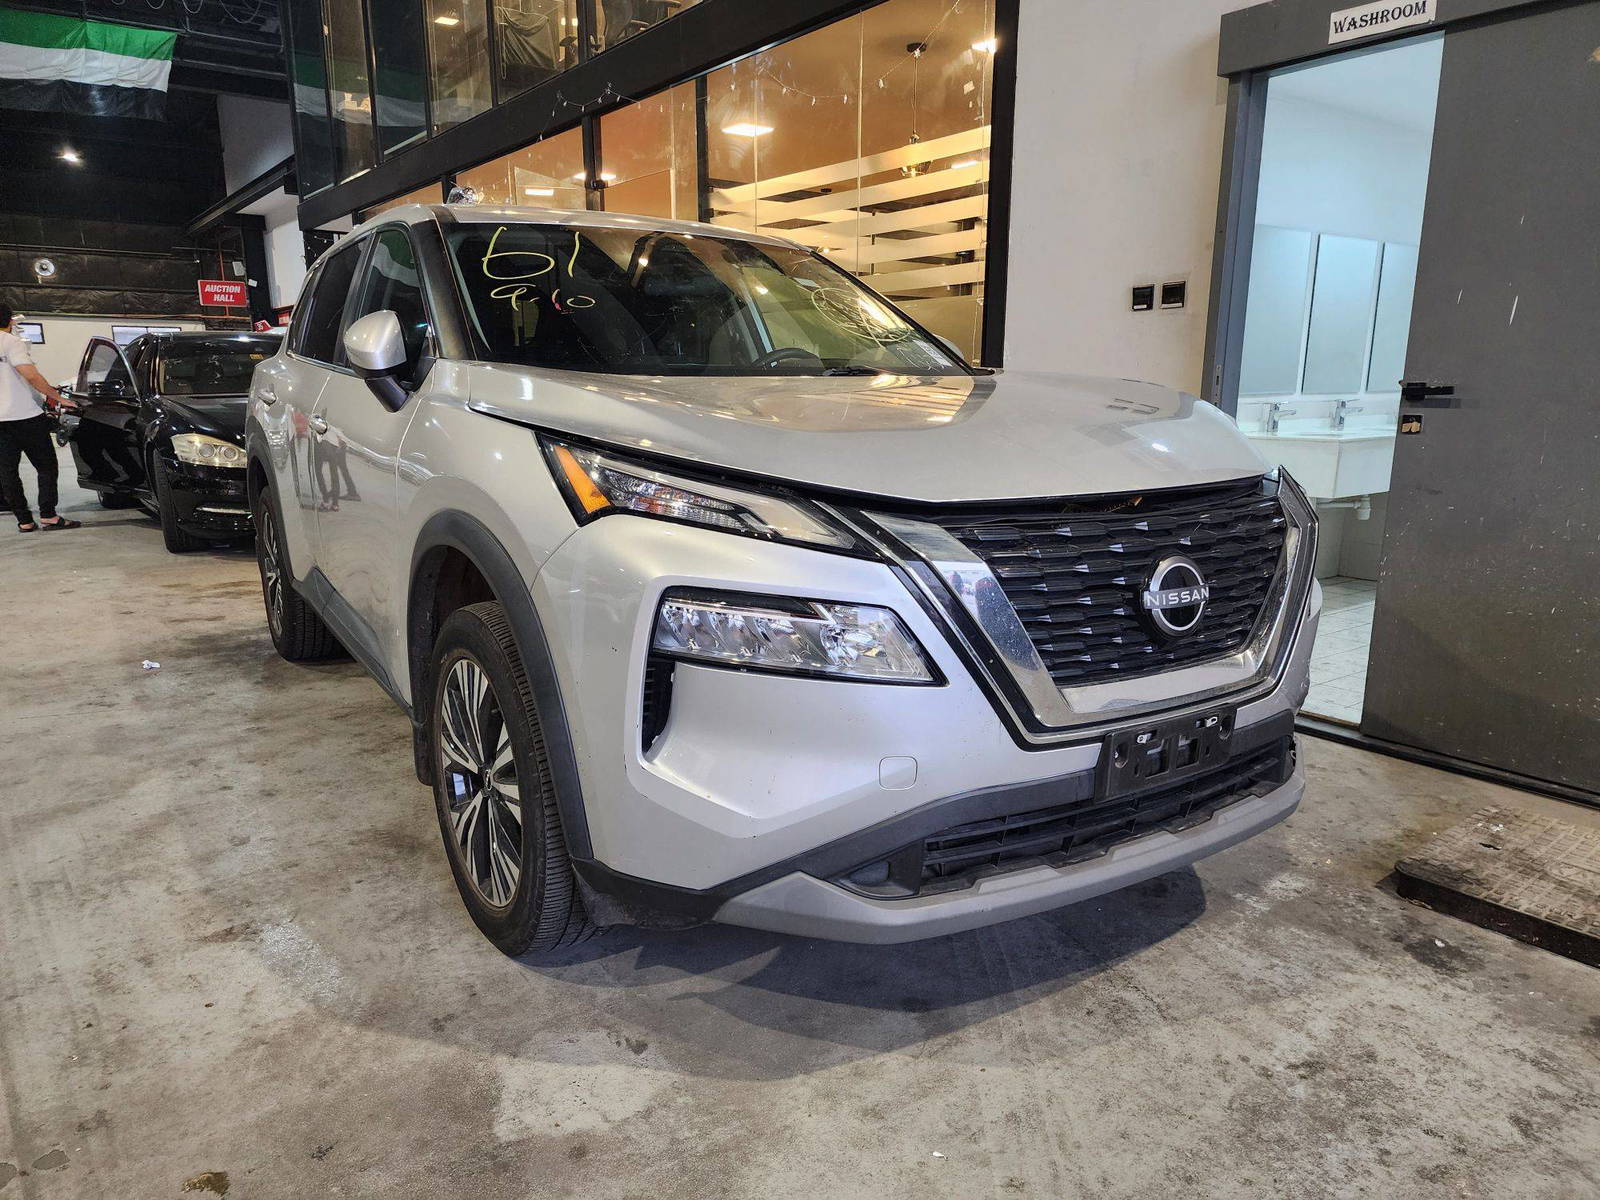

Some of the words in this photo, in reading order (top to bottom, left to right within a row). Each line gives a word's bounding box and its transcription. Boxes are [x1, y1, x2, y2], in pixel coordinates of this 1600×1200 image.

[1333, 0, 1427, 34] WASHROOM
[204, 284, 241, 294] AUCTION
[213, 293, 235, 302] HALL
[1146, 586, 1209, 607] NISSAN
